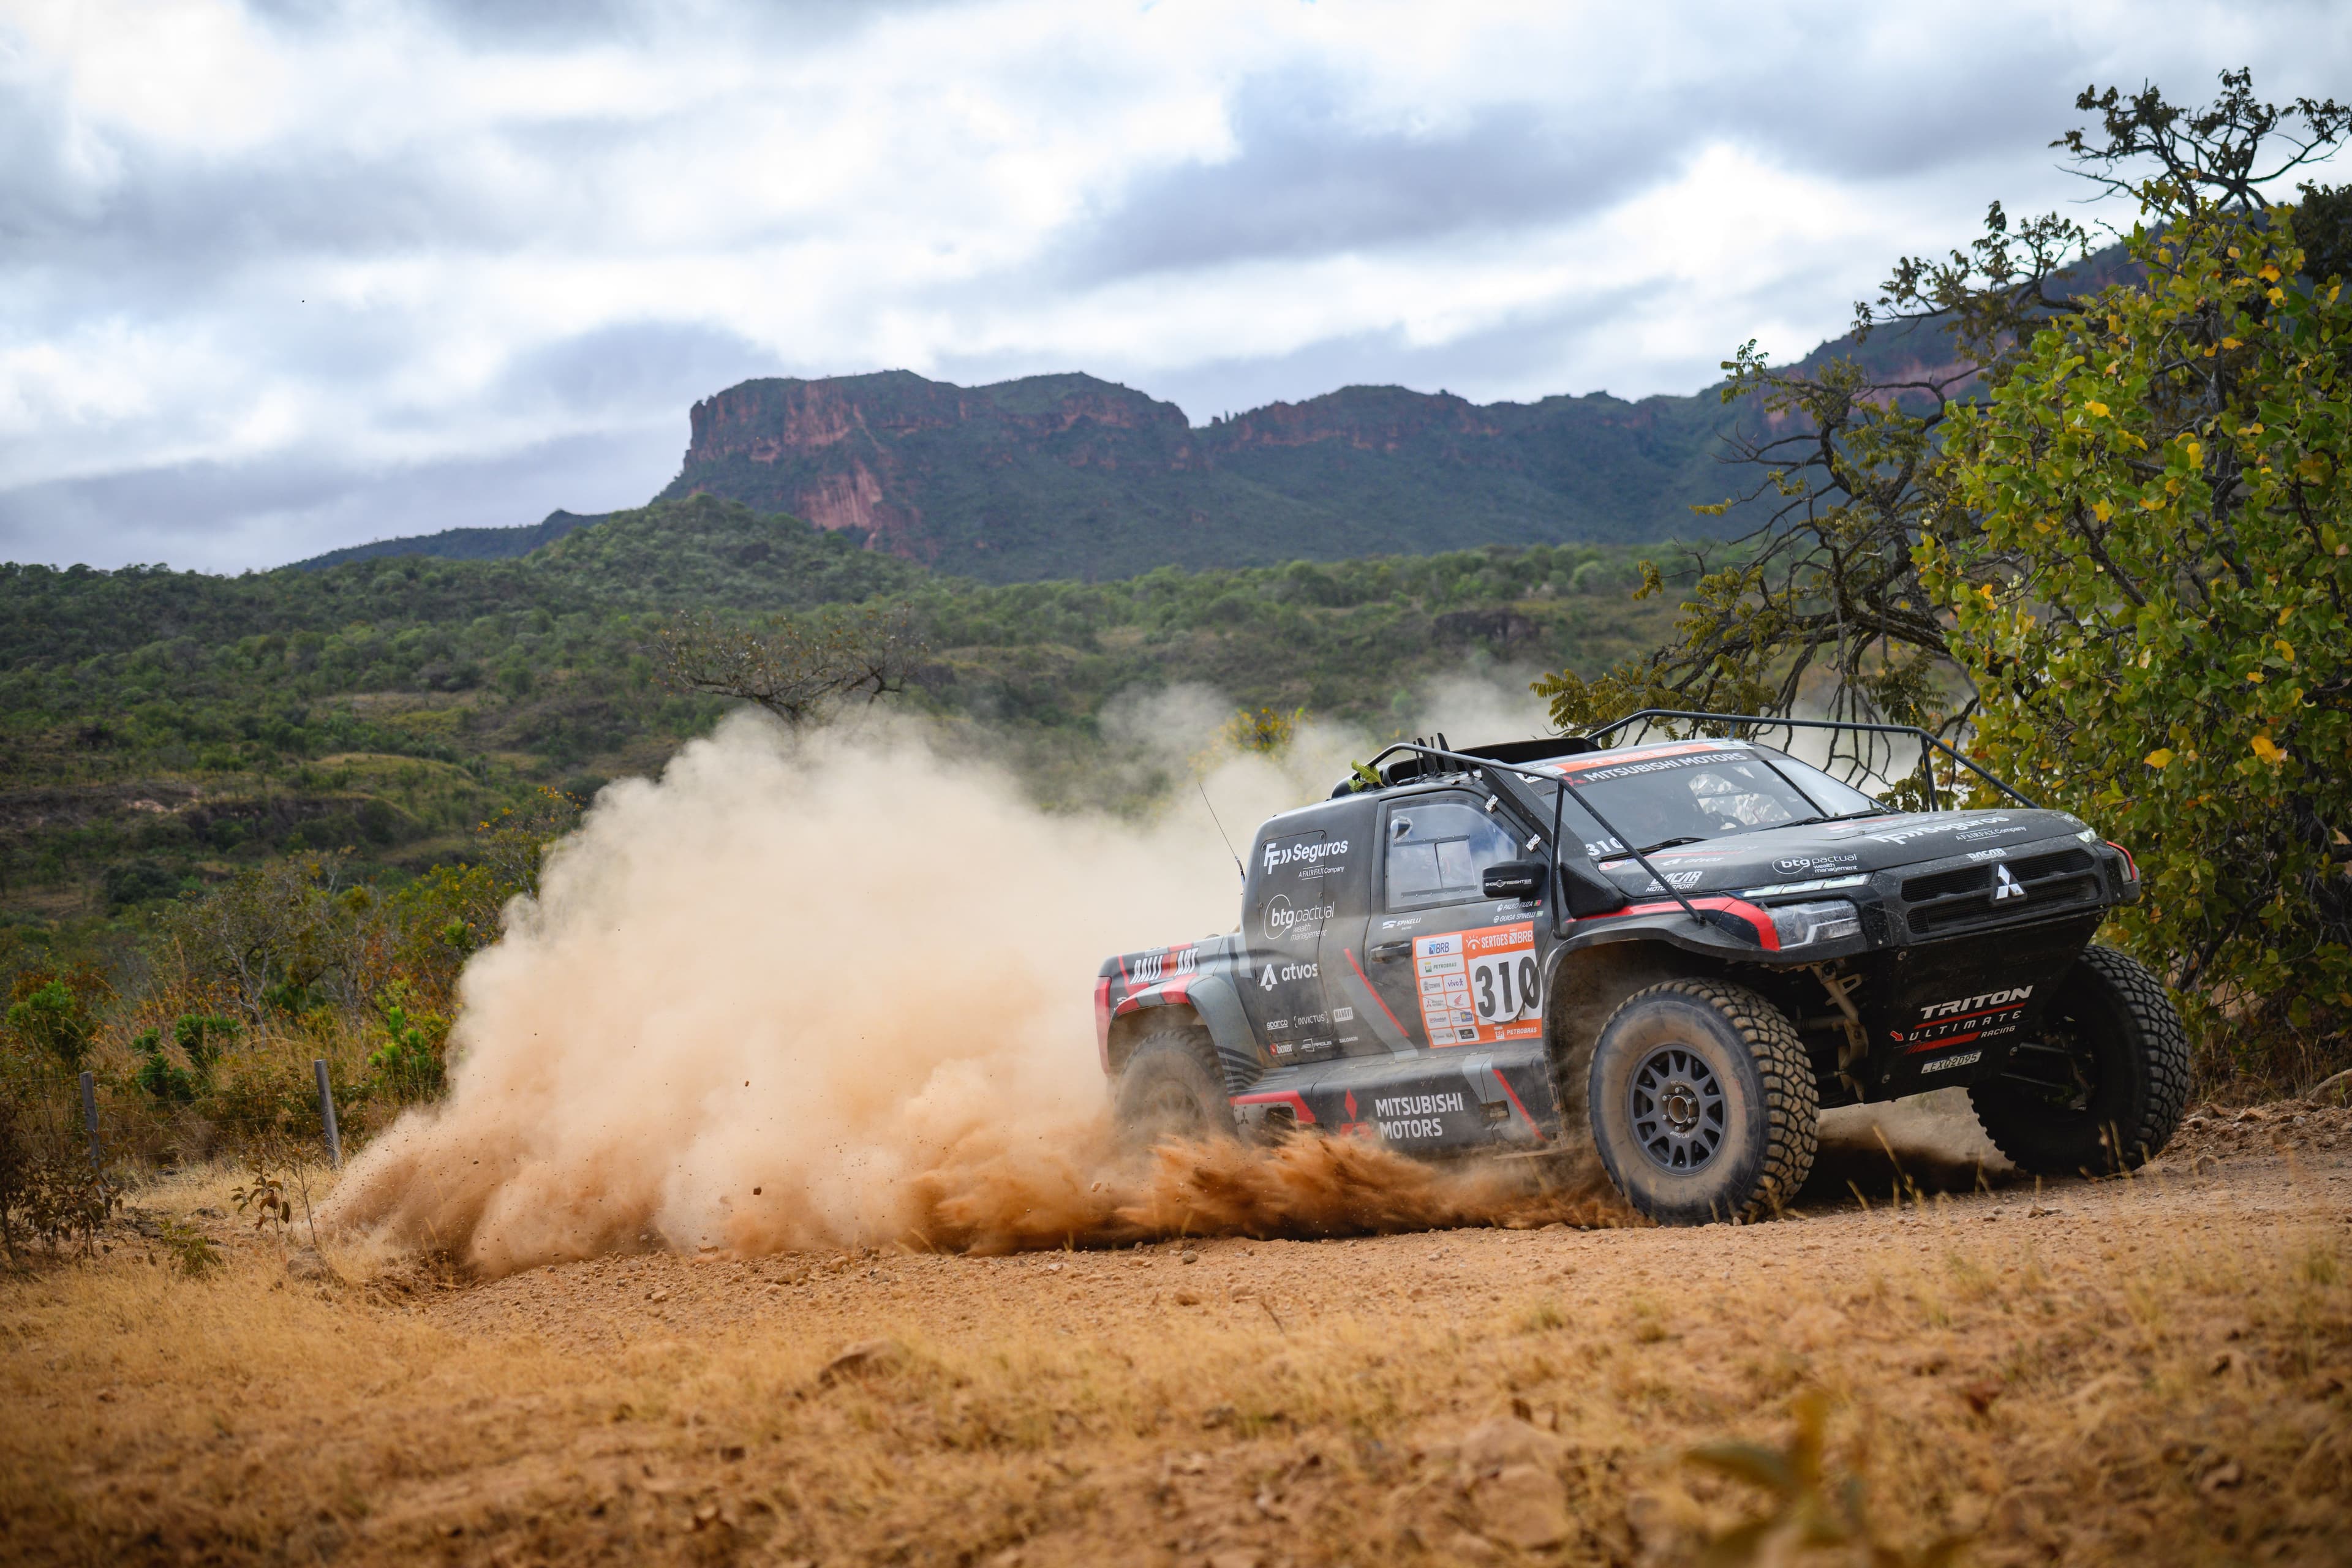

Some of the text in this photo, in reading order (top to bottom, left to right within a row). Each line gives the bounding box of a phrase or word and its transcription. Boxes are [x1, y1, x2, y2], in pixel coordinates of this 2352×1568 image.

[1583, 760, 1681, 782] MITSUBISHI
[1679, 753, 1748, 766] MOTORS
[1917, 816, 2010, 833] Seguros
[1961, 829, 1995, 840] FAIRFAX
[1994, 826, 2027, 834] Company
[1292, 840, 1349, 863] Seguros
[1586, 837, 1624, 856] 310
[1781, 853, 1857, 869] btg pactual
[1302, 867, 1324, 877] FAIRFAX
[1646, 883, 1695, 892] MOTOSPORT
[1271, 901, 1335, 929] btg pactual
[1396, 917, 1421, 926] SPINELLI
[1516, 911, 1536, 920] SPINELLI
[1293, 923, 1311, 933] wealth
[1291, 929, 1327, 941] management
[1517, 930, 1533, 943] BRB
[1436, 942, 1449, 954] BRB
[1281, 963, 1319, 981] atvos
[1475, 956, 1541, 1019] 310
[1920, 985, 2034, 1020] TRITON
[1267, 1019, 1288, 1030] sparco
[1297, 1014, 1325, 1026] INVICTUS
[1909, 1011, 2021, 1041] ULTIMATE
[1507, 1027, 1537, 1035] PETROBRAS
[1981, 1025, 2016, 1038] RACING
[1276, 1044, 1293, 1054] boxer
[1374, 1093, 1464, 1117] MITSUBISHI
[1379, 1118, 1443, 1139] MOTORS
